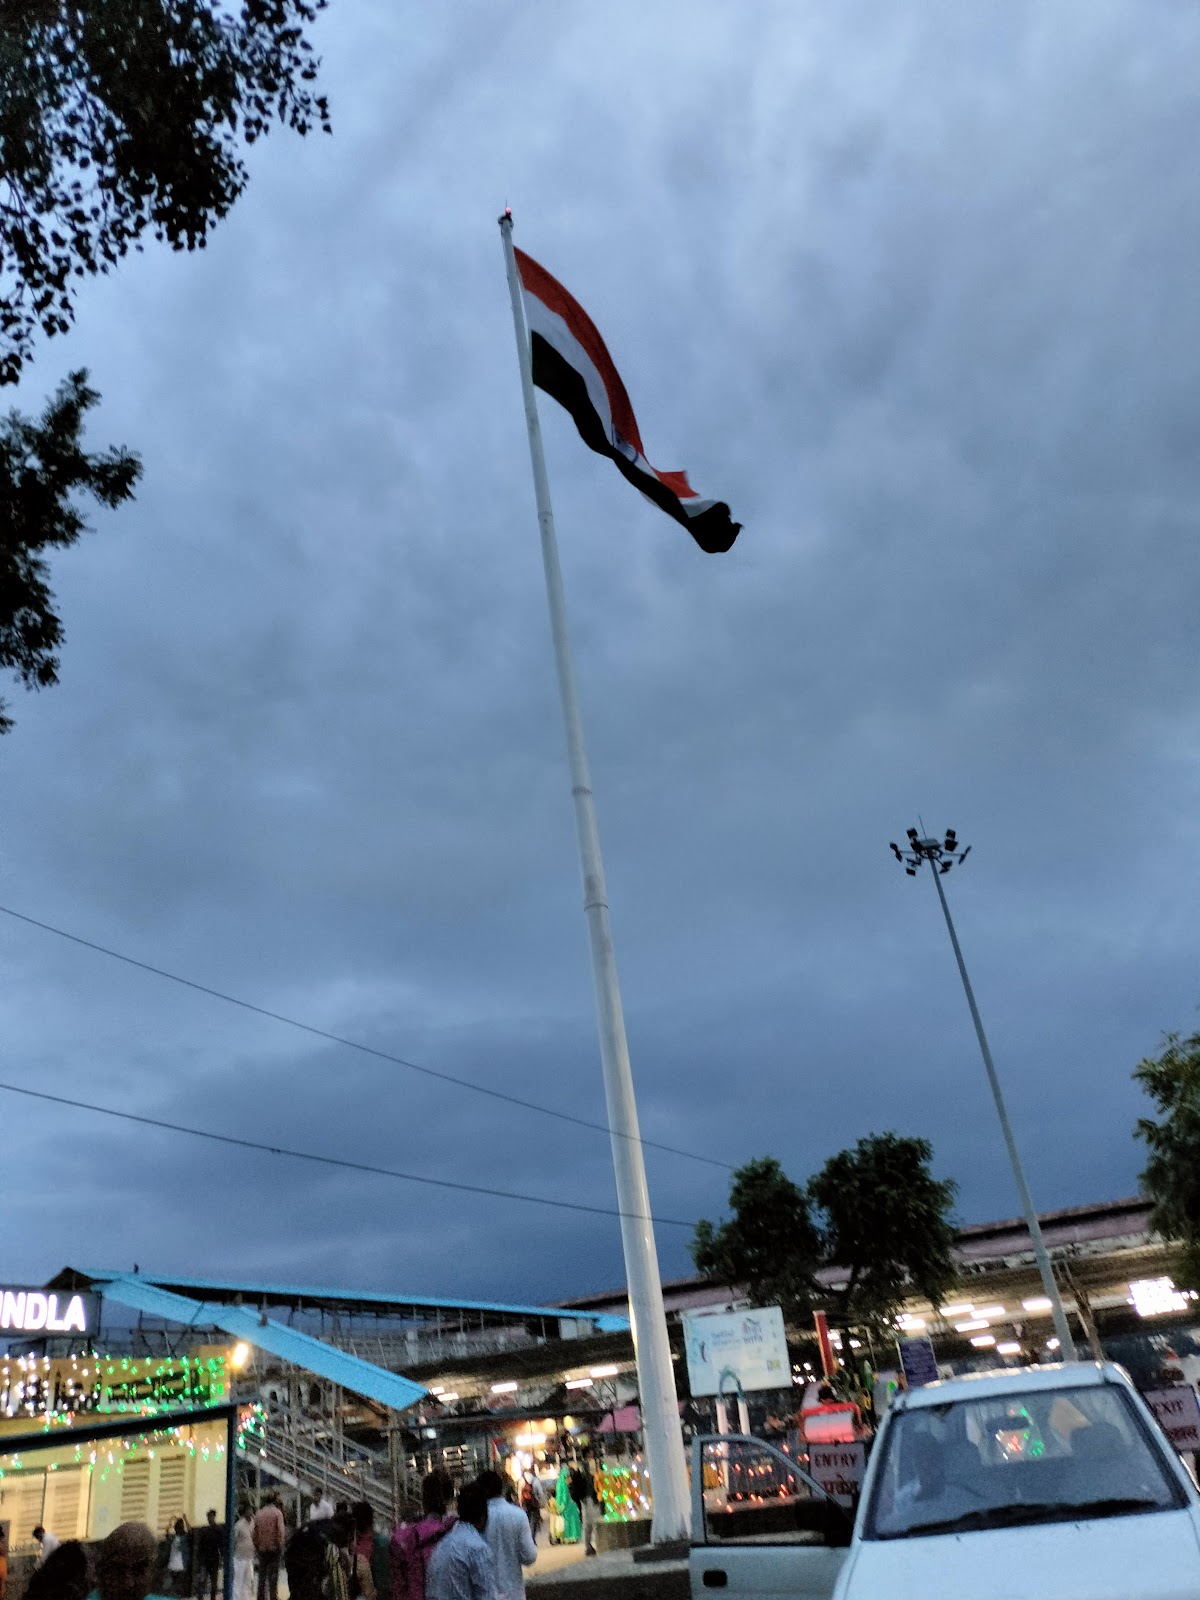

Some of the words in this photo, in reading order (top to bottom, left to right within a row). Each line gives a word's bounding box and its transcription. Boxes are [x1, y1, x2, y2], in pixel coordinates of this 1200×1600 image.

[0, 1290, 86, 1331] NDLA
[1152, 1399, 1184, 1415] EXIT
[814, 1452, 858, 1467] ENTRY
